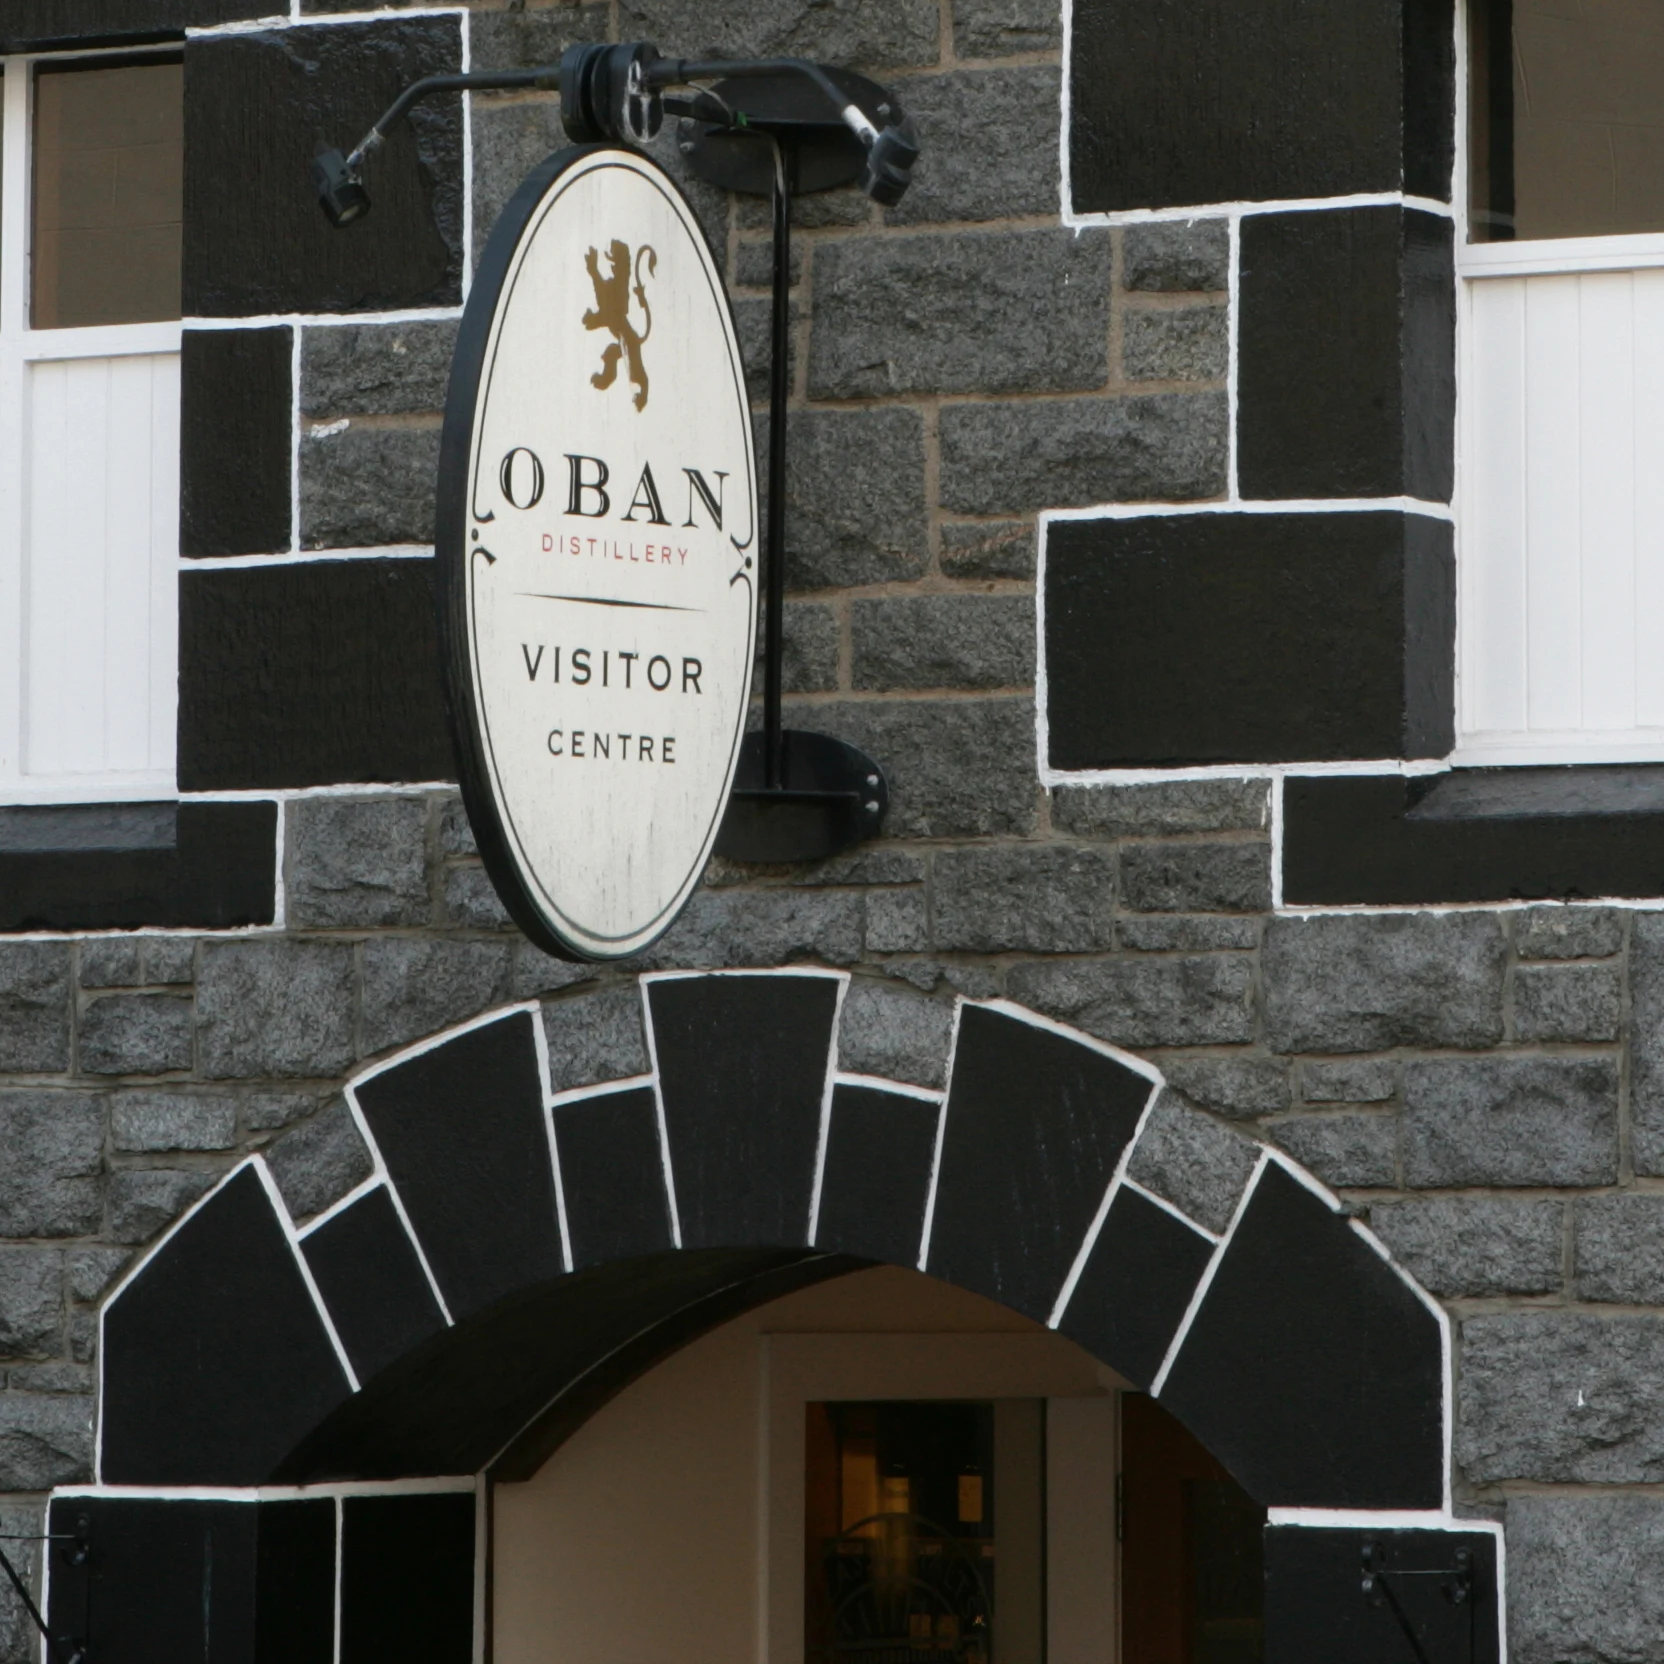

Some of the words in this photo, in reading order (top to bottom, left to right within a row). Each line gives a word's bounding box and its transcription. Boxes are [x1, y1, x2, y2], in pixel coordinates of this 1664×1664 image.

[499, 447, 730, 532] OBAN
[542, 534, 689, 566] DISTILLERY
[521, 642, 703, 694] VISITOR
[547, 729, 677, 763] CENTRE
